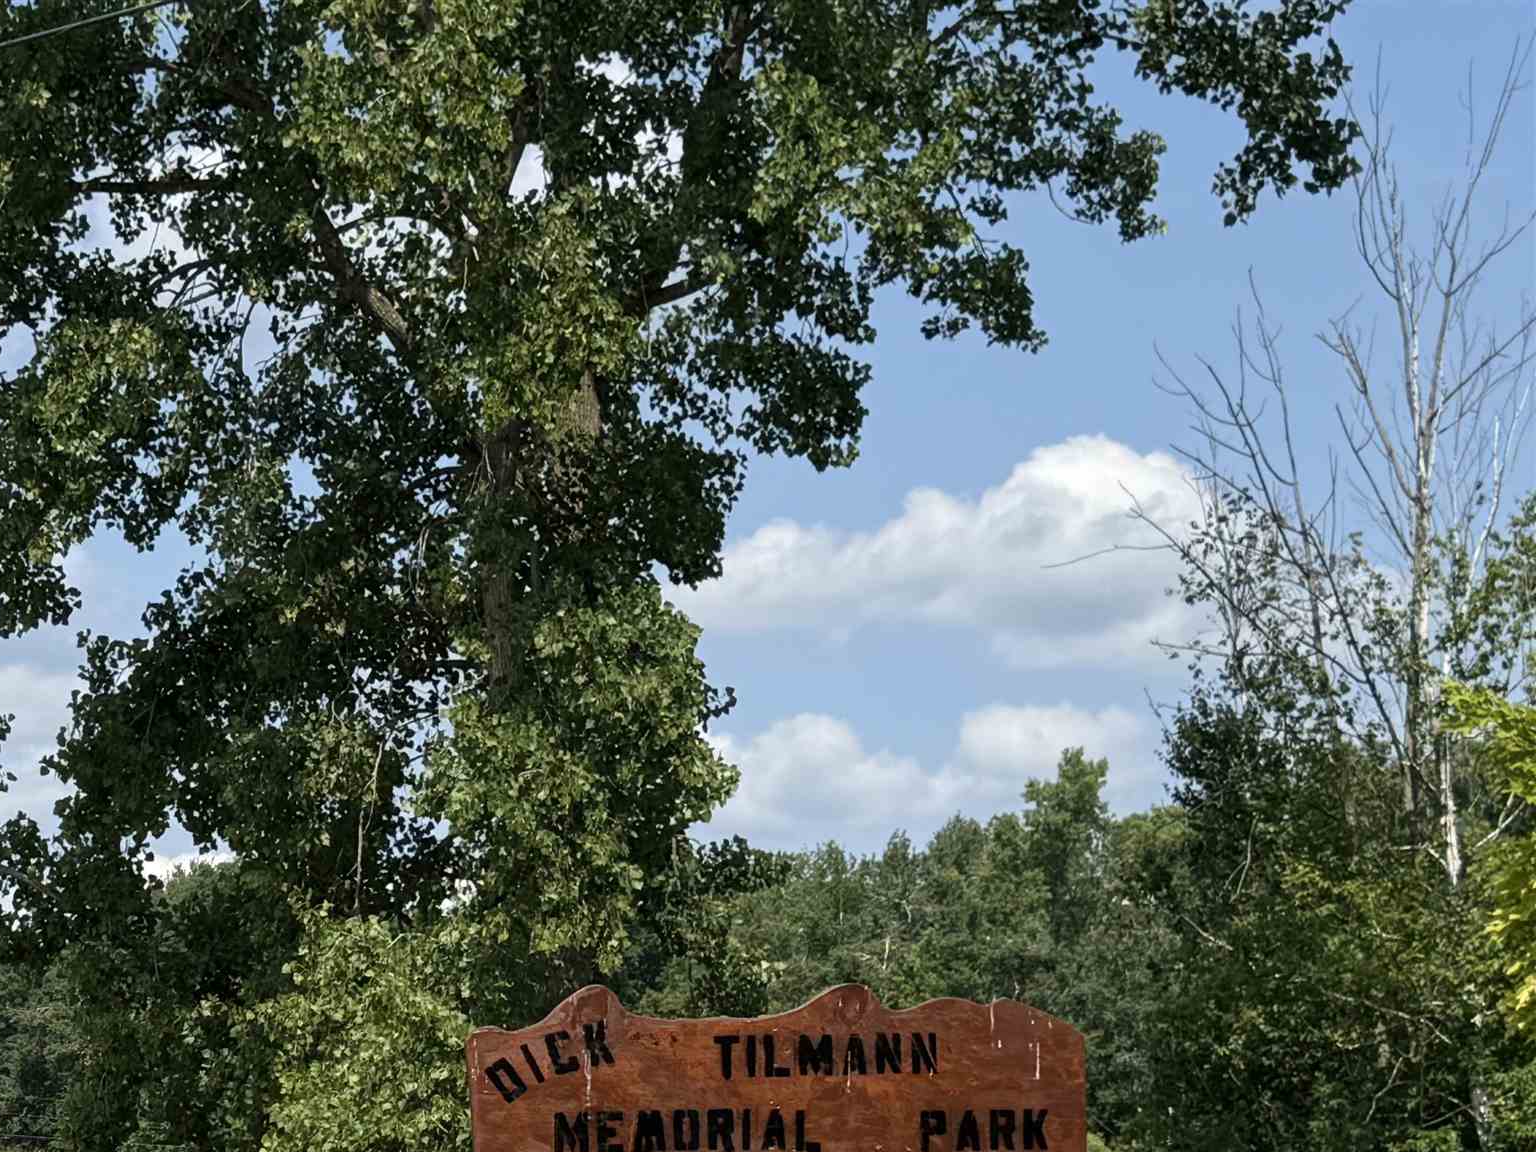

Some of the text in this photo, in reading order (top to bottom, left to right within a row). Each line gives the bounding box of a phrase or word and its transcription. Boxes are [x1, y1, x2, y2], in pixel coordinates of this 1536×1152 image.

[484, 1019, 938, 1104] DICK TILMANN
[919, 1108, 1049, 1152] PARK
